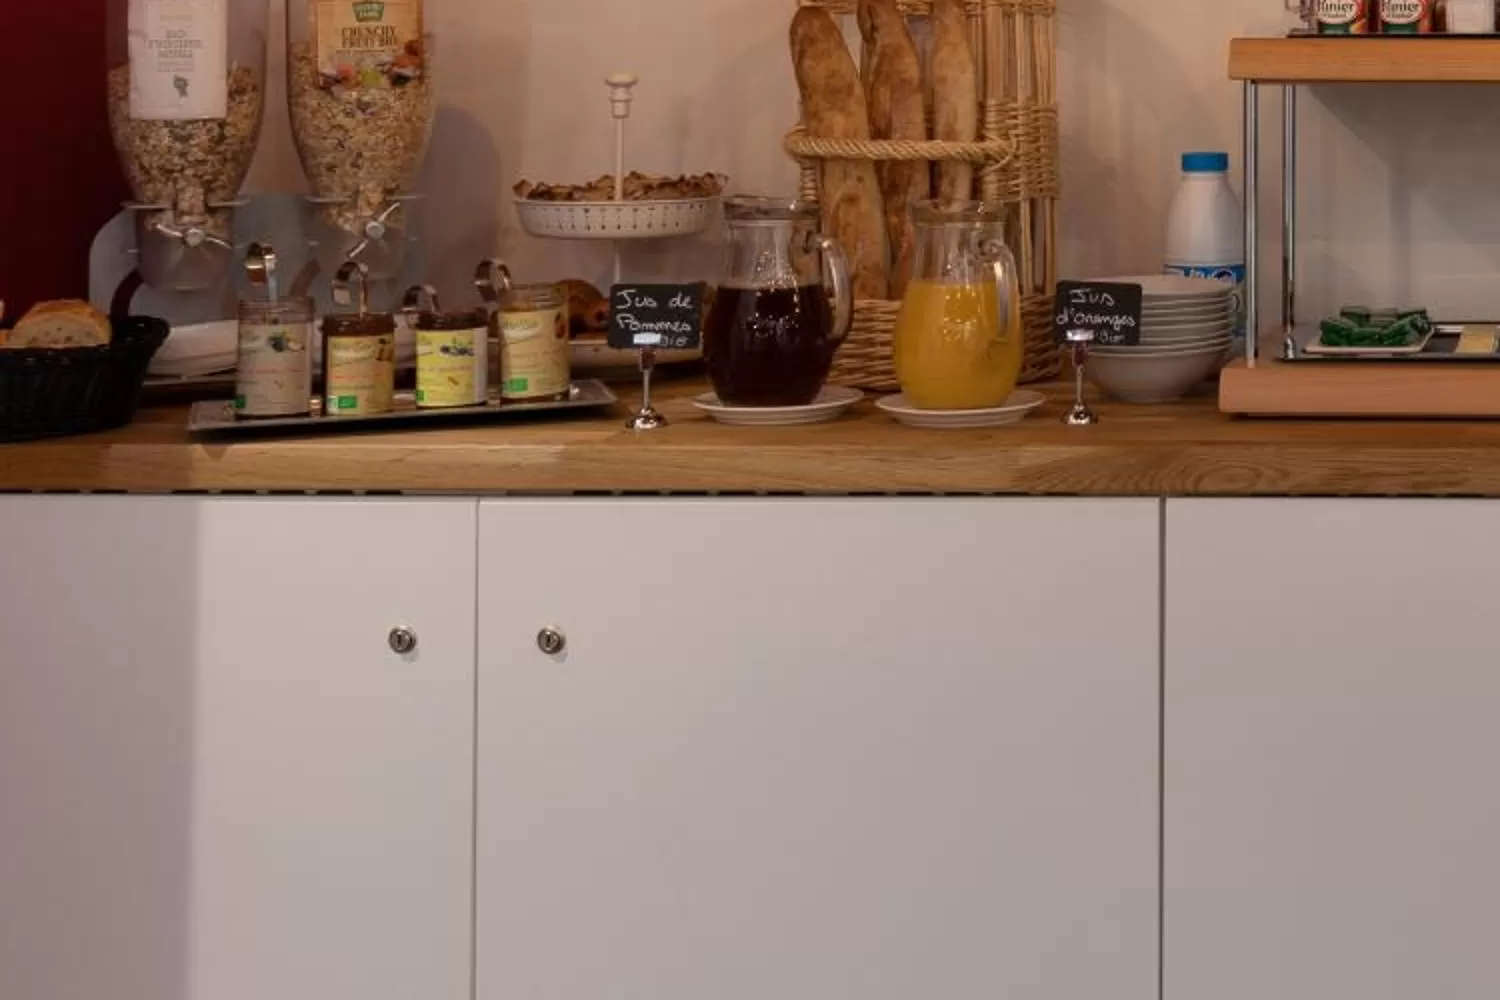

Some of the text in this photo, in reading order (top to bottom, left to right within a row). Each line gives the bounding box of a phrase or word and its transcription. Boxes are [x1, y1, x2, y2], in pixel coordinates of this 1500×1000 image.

[615, 289, 694, 310] Jus de
[1068, 288, 1115, 306] Jus
